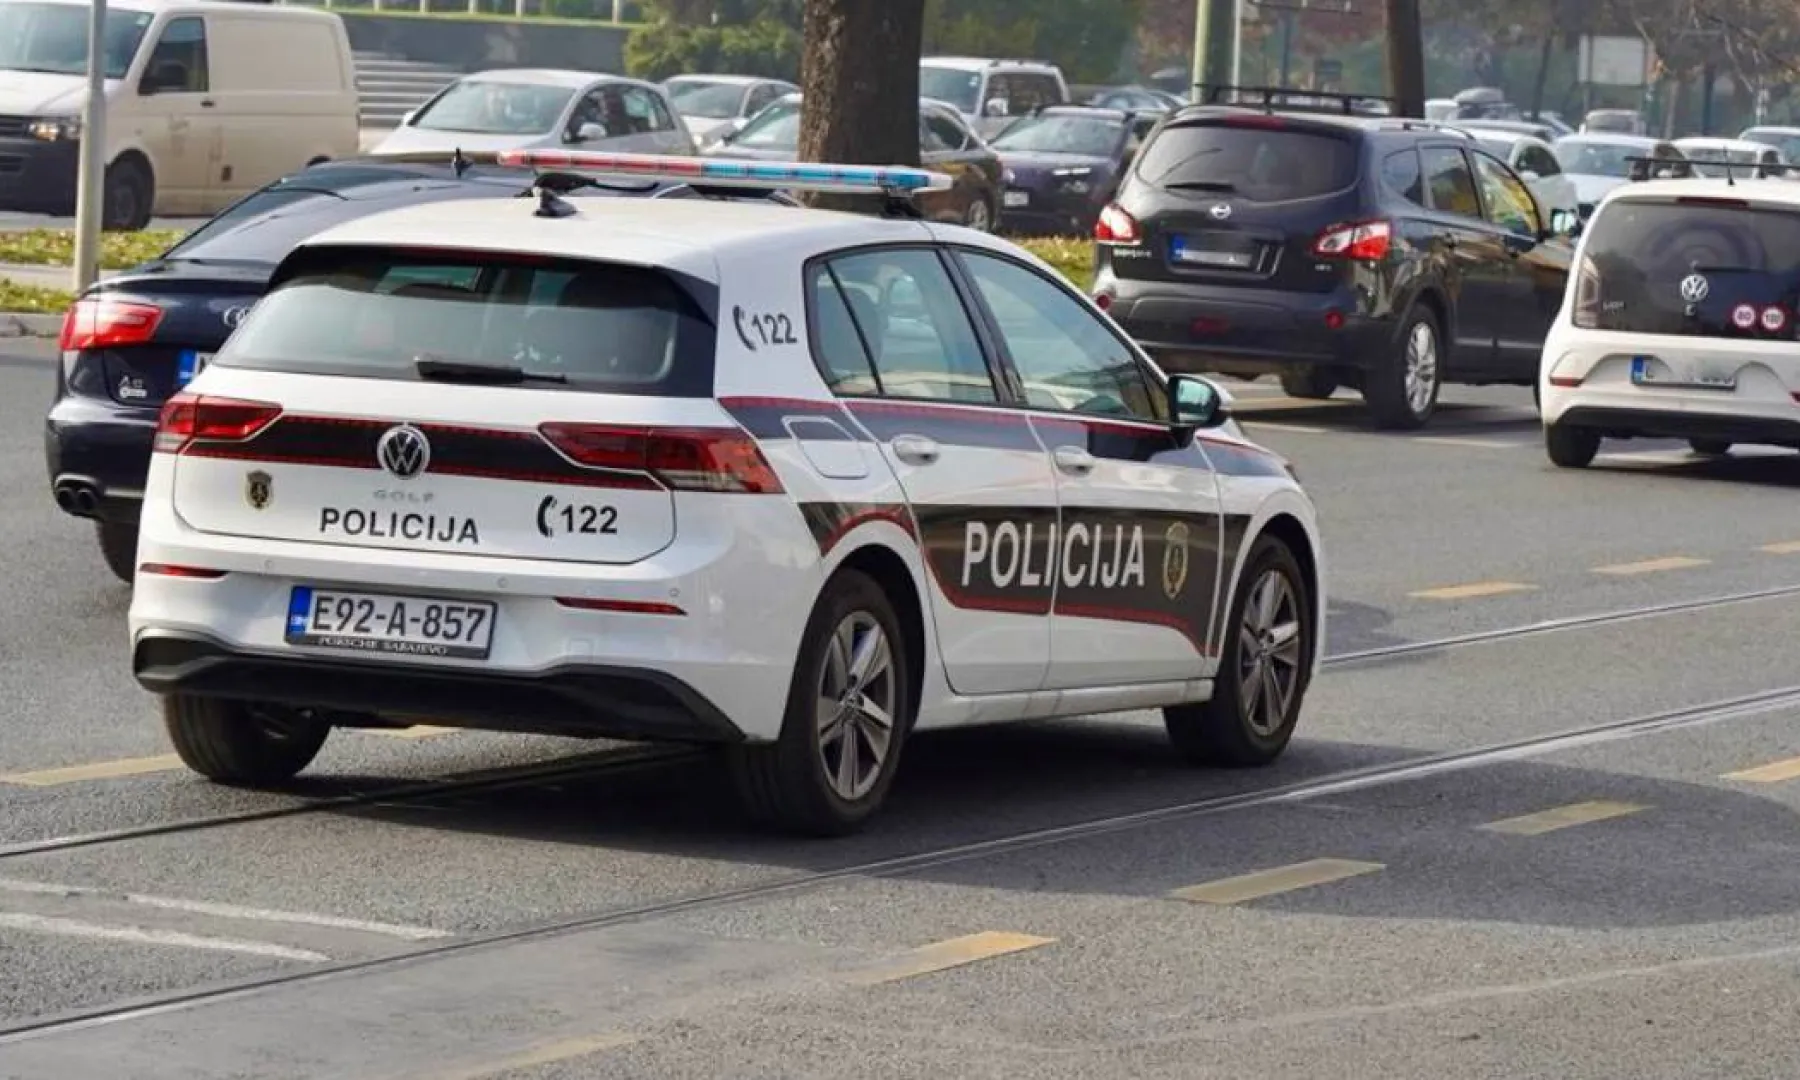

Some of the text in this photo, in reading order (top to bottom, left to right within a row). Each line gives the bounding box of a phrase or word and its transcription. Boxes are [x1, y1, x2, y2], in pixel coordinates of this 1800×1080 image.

[752, 313, 798, 344] 122
[373, 489, 435, 502] GOLF
[320, 507, 479, 545] POLICIJA
[561, 505, 618, 534] 122
[961, 520, 1145, 588] POLICIJA
[312, 595, 486, 642] E92-A-857
